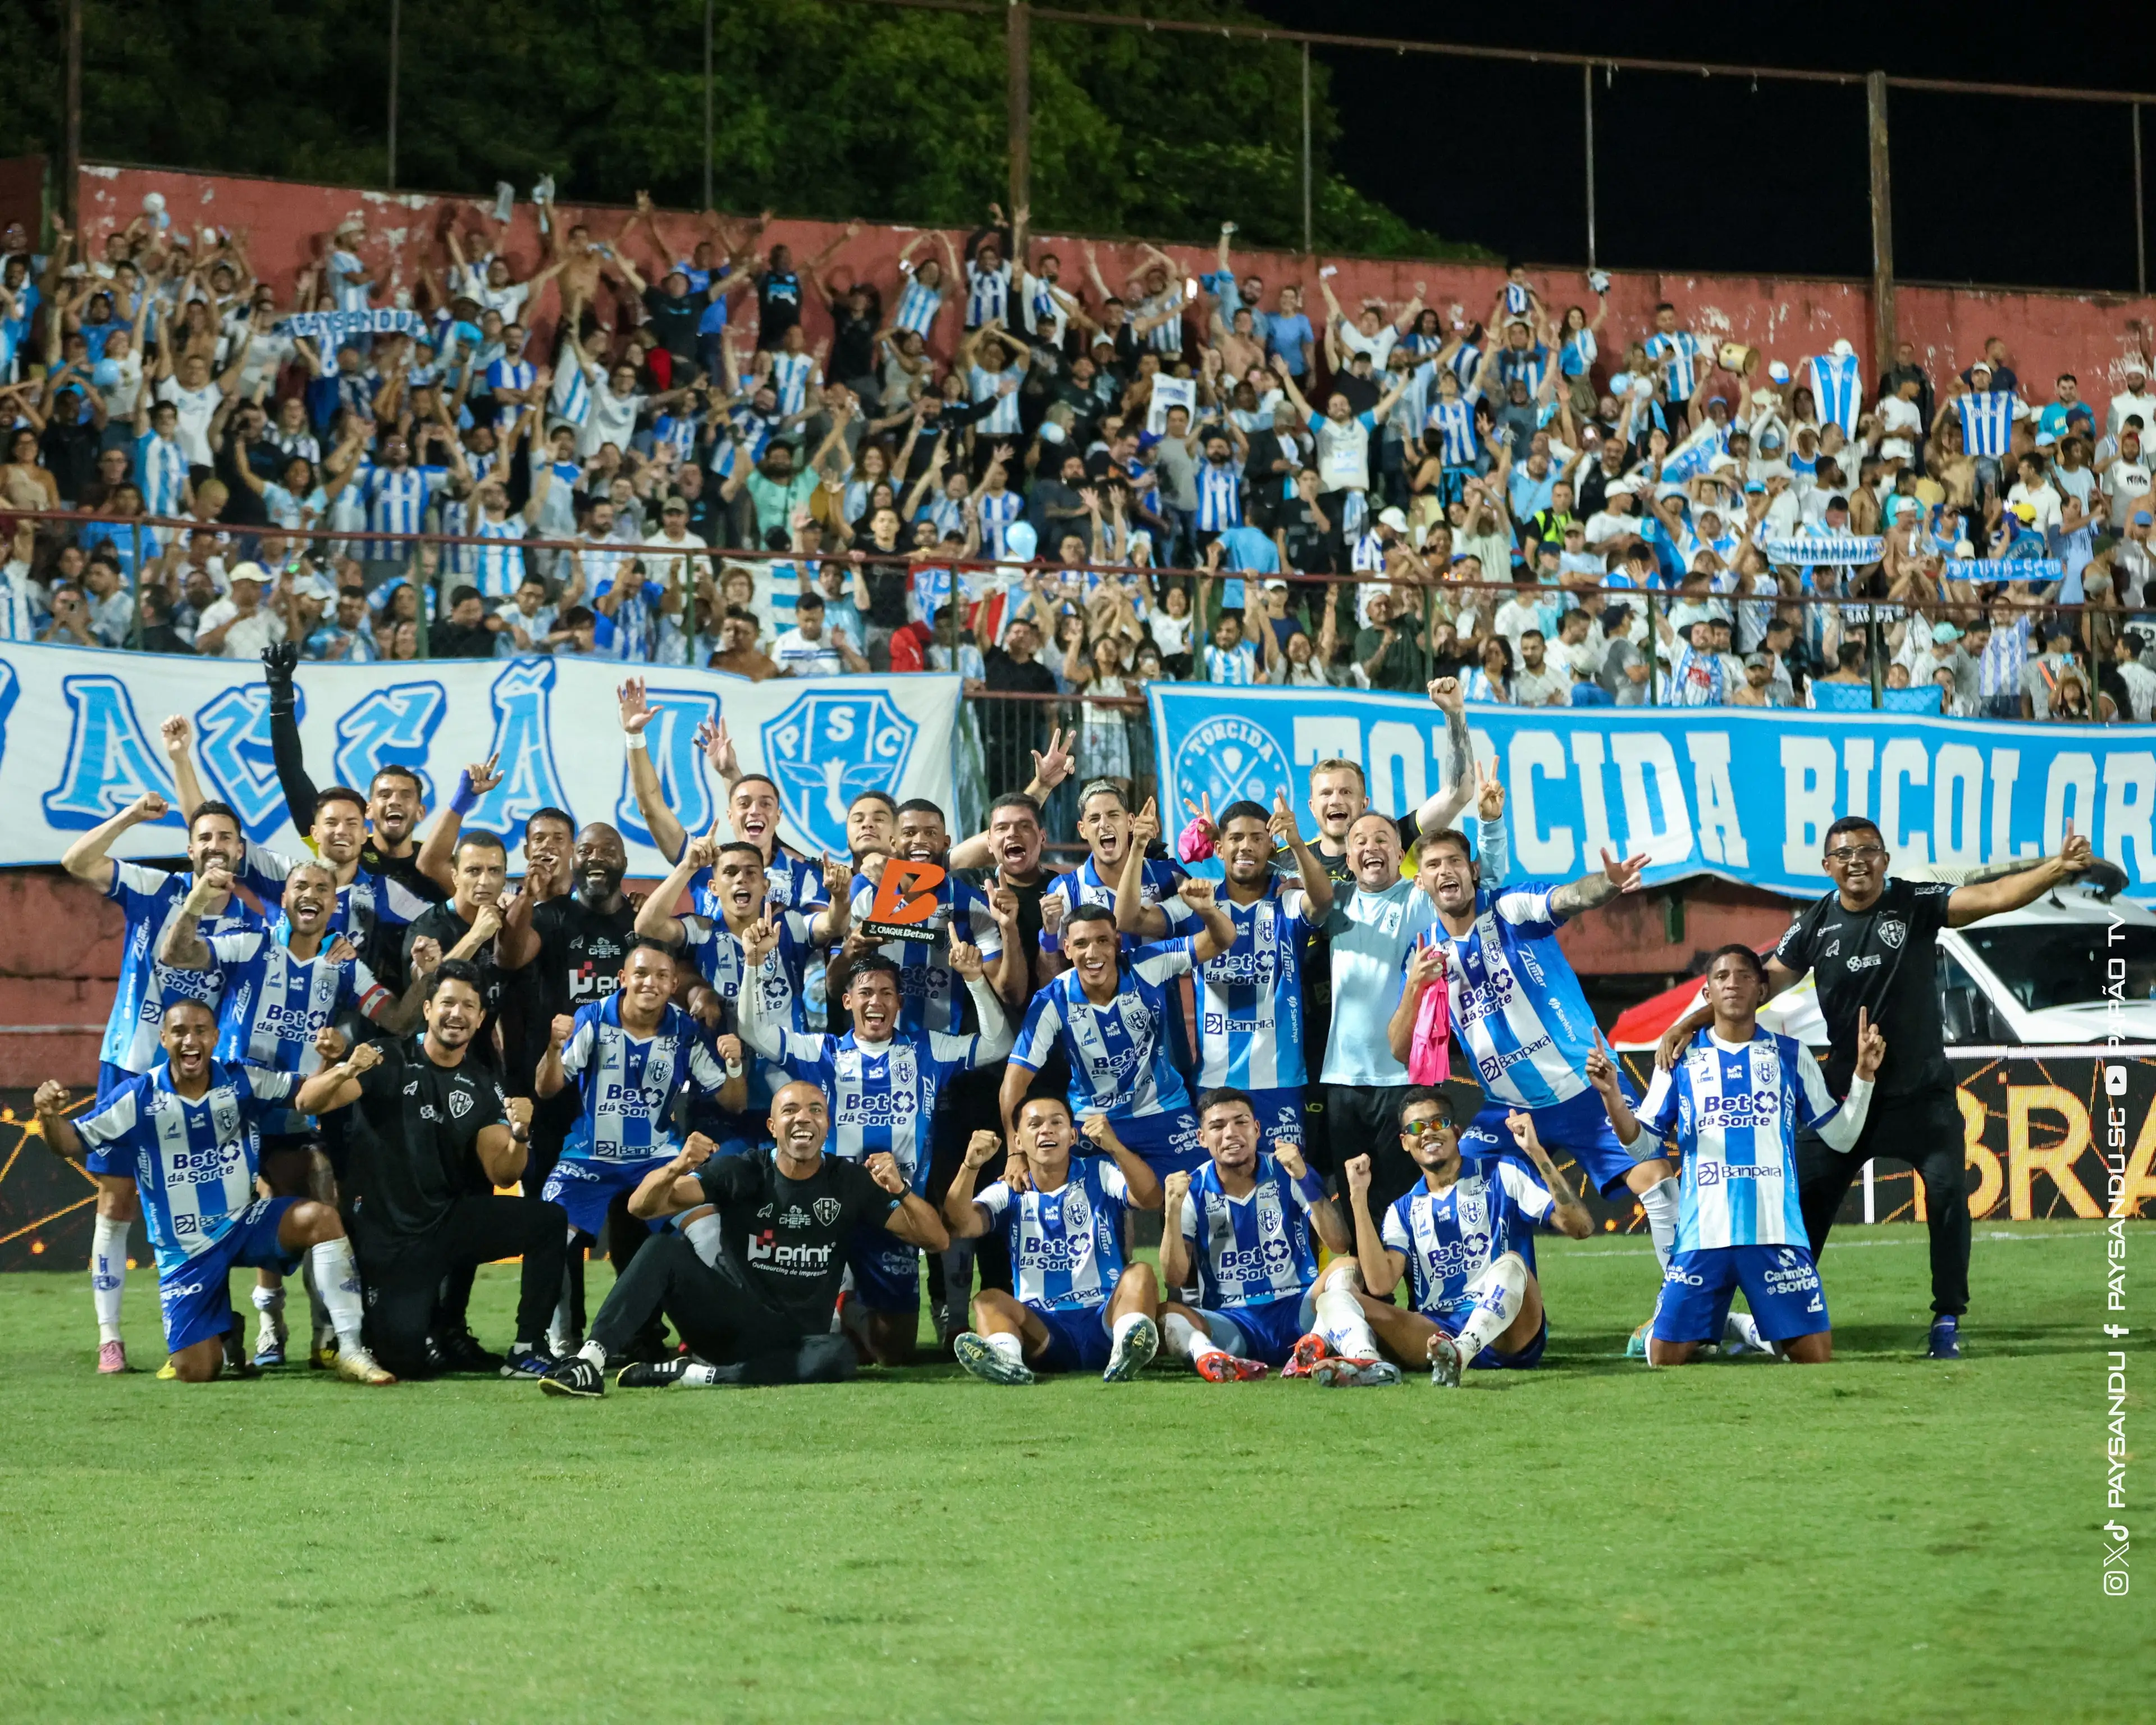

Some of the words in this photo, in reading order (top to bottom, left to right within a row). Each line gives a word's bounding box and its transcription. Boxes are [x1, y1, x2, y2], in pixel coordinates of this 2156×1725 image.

[1187, 721, 1273, 763] TORCIDA
[1780, 736, 2156, 884] BICOLOR
[877, 925, 903, 937] CRAQUE
[903, 929, 935, 941] Betano
[1211, 952, 1254, 970] Bet
[1280, 939, 1295, 984] Zilmar
[1518, 942, 1547, 989] Zilmar
[1205, 971, 1221, 984] dá
[1222, 971, 1271, 985] Sorte
[1459, 979, 1493, 1011] Bet
[266, 1003, 307, 1029] Bet
[1460, 1011, 1477, 1027] dá
[1478, 992, 1513, 1019] Sorte
[257, 1019, 273, 1032] dá
[275, 1024, 317, 1043] Sorte
[1225, 1017, 1275, 1032] Banpará
[1290, 1010, 1299, 1044] Sankhya
[1555, 1008, 1577, 1042] Sankhya
[1093, 1047, 1134, 1068] Bet
[1497, 1034, 1552, 1070] Banpará
[606, 1084, 647, 1106] Bet
[846, 1093, 890, 1111] Bet
[922, 1073, 936, 1121] Zilmar
[1704, 1094, 1751, 1112] Bet
[599, 1102, 616, 1113] dá
[618, 1104, 650, 1118] Sor
[838, 1112, 855, 1124] dá
[857, 1112, 907, 1126] Sorte
[1698, 1116, 1715, 1128] dá
[1717, 1114, 1770, 1128] Sorte
[1461, 1128, 1499, 1144] APÃO
[173, 1149, 215, 1170] Bet
[167, 1171, 185, 1184] dá
[187, 1164, 235, 1185] Sorte
[1721, 1164, 1782, 1179] Banpará
[779, 1217, 811, 1226] CHEFE
[1025, 1238, 1065, 1256] Bet
[1020, 1257, 1034, 1267] dá
[1221, 1247, 1263, 1268] Bet
[752, 1261, 788, 1275] Outsourcing
[1217, 1270, 1233, 1281] dá
[1236, 1263, 1285, 1282] Sorte
[1764, 1262, 1812, 1283] Carimbó
[1664, 1271, 1703, 1286] APÃO
[1777, 1276, 1819, 1294] sorte
[159, 1283, 203, 1299] APÃO
